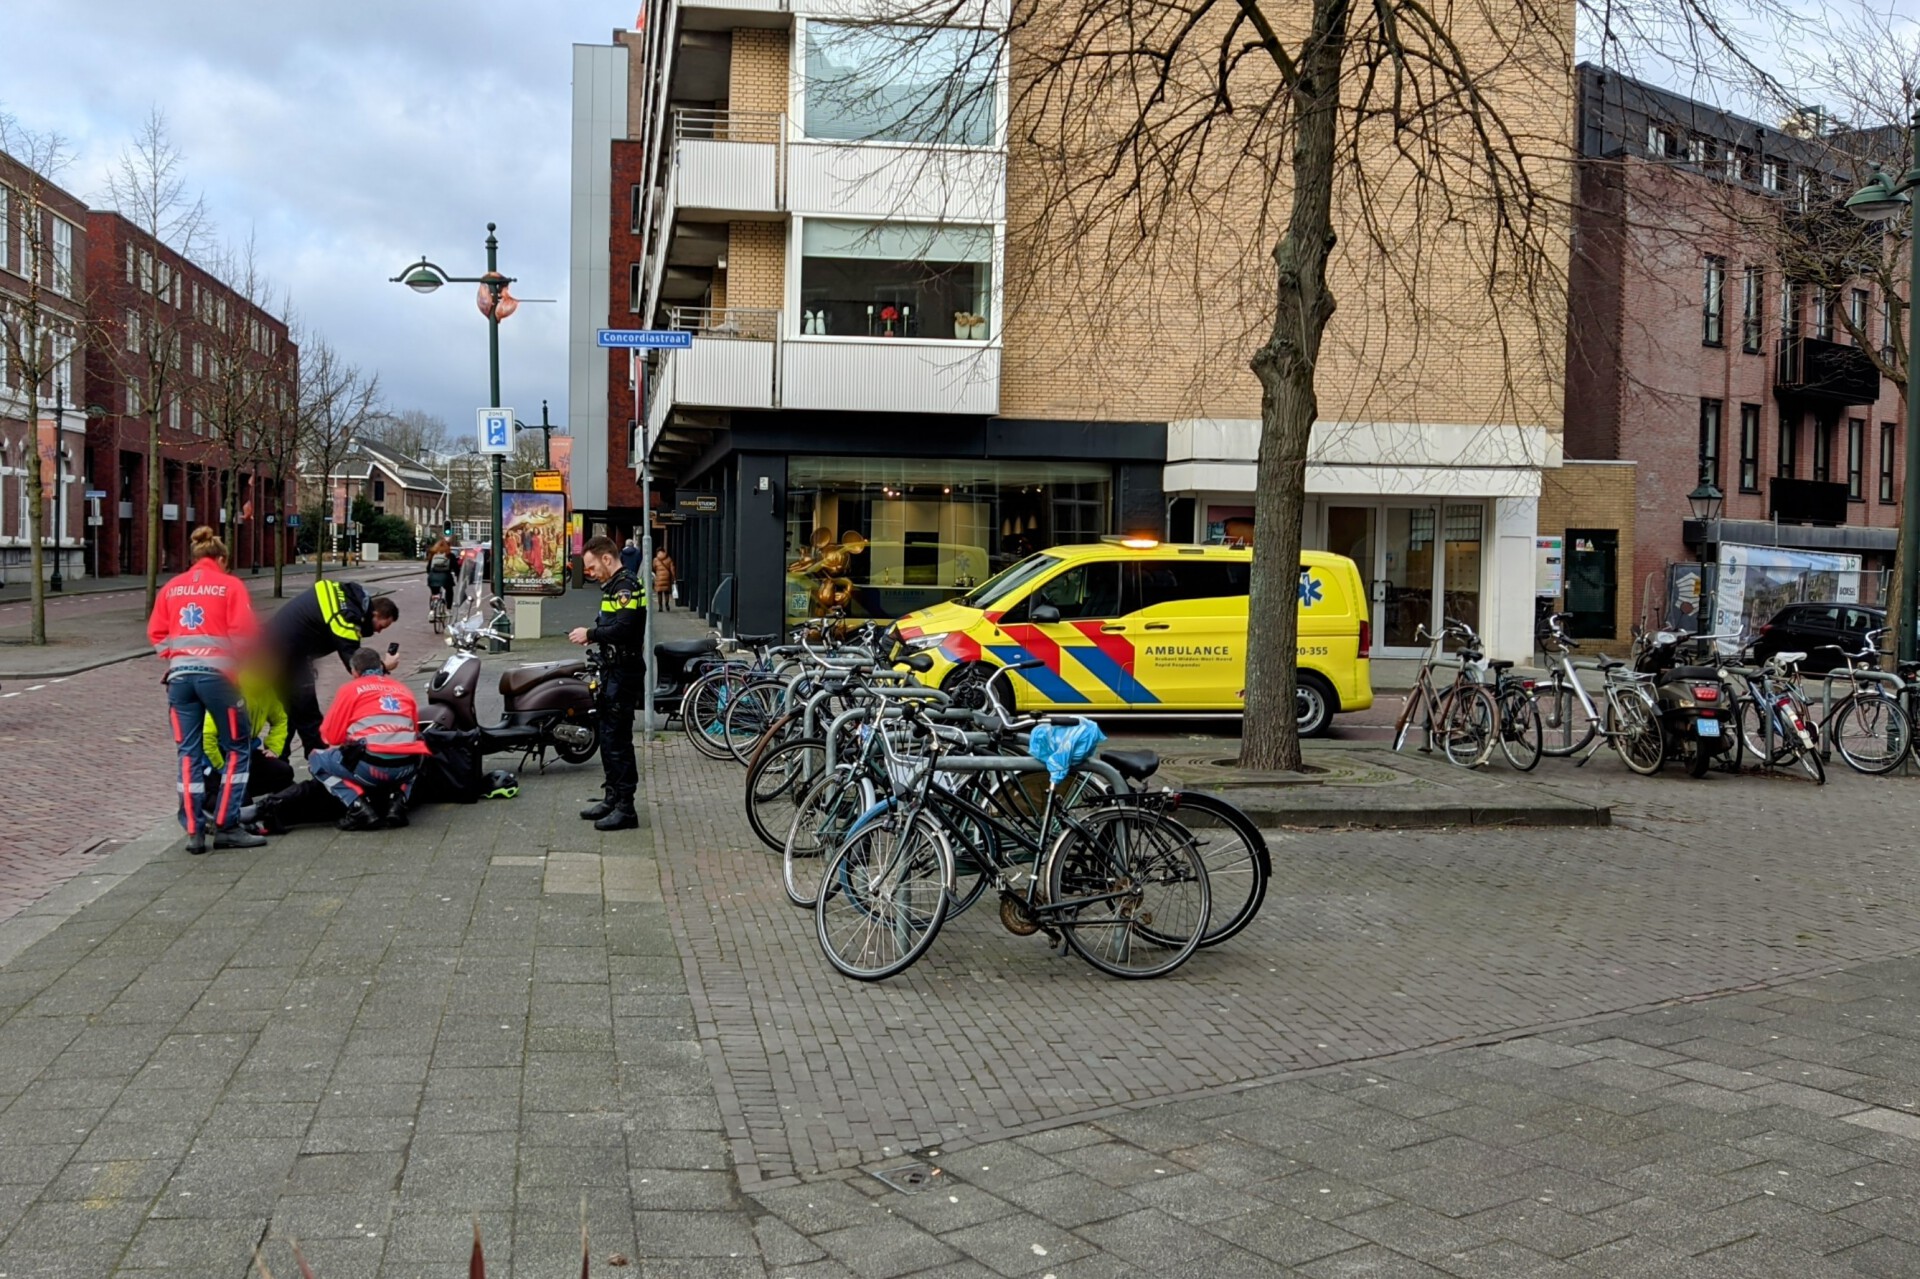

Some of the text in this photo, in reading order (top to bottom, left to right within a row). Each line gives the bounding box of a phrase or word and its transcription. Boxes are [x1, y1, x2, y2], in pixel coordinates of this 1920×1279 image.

[603, 332, 686, 343] Concordiastraat
[490, 419, 502, 435] P
[1145, 646, 1230, 656] AMBULANCE
